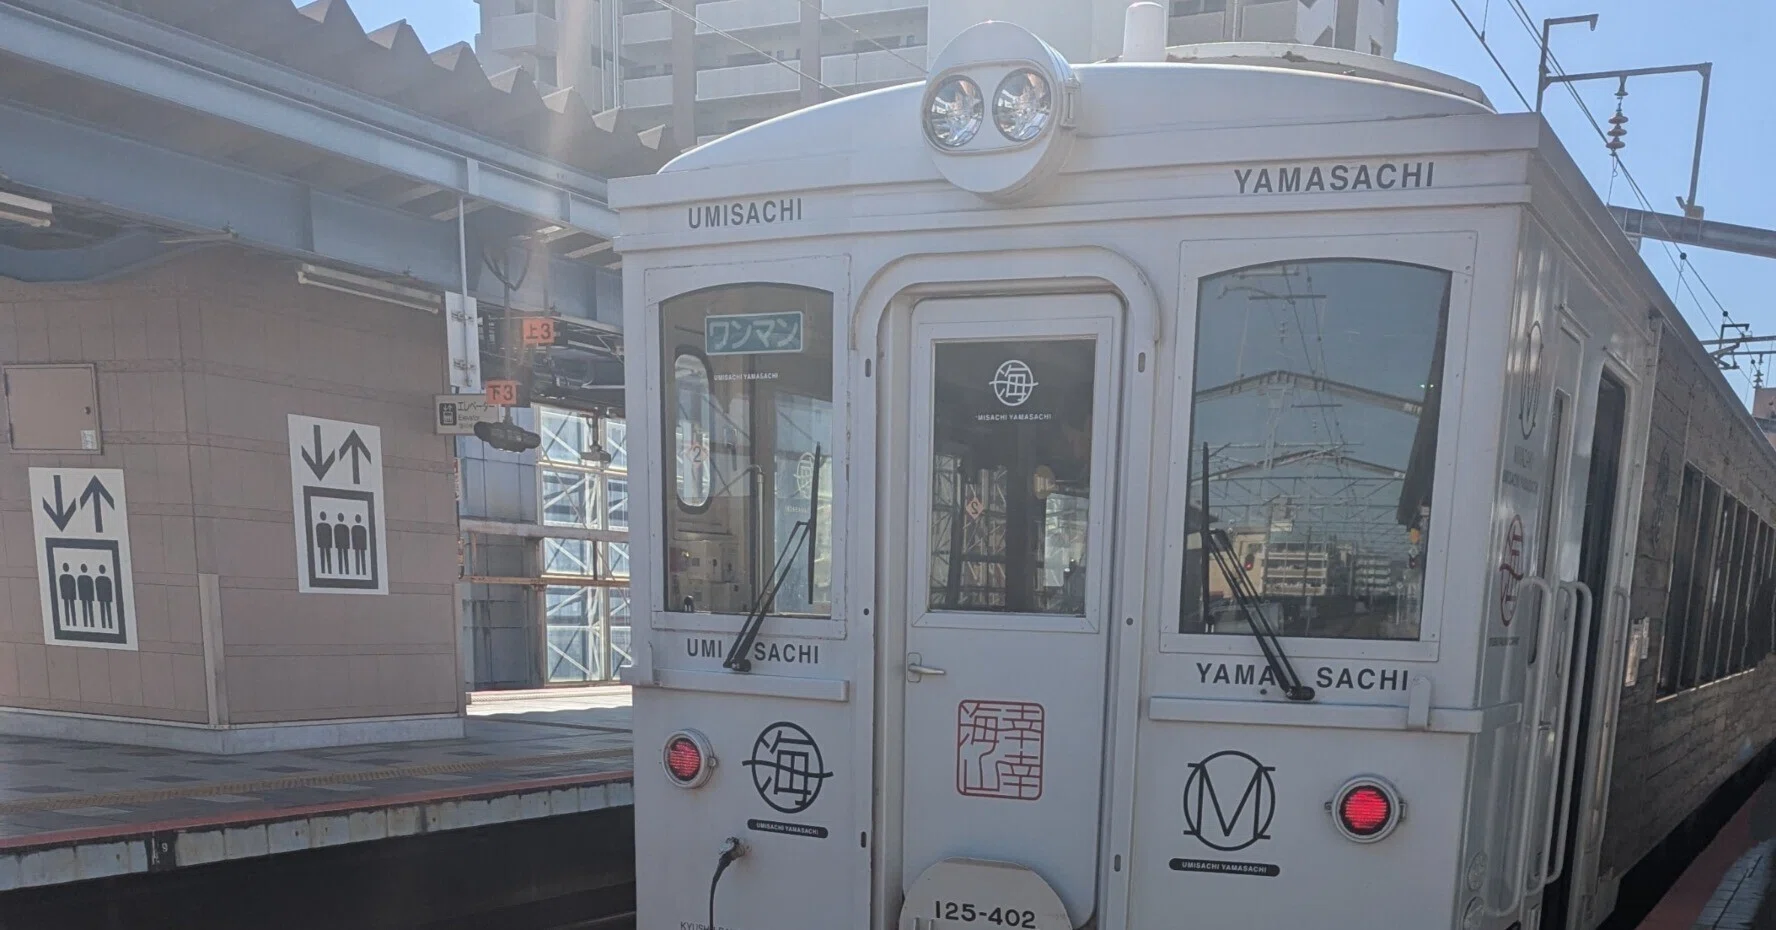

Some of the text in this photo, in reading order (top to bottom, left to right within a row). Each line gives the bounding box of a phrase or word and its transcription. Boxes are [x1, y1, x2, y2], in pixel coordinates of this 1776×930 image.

[1234, 161, 1434, 194] YAMASACHI
[688, 197, 802, 229] UMISACHI
[525, 322, 552, 340] 上3
[708, 318, 799, 350] ワンマン
[713, 372, 779, 381] UMISACHI YAMASACHI
[988, 360, 1040, 406] 海
[487, 383, 514, 401] 下3
[976, 412, 1052, 421] MISACHI YAMASACHI
[686, 638, 819, 664] UMI SACHI
[1196, 662, 1409, 691] YAMA SACHI
[742, 721, 834, 814] 海
[756, 822, 819, 835] UMISACHI YAMASACHI
[1181, 861, 1267, 873] UMISACHI YAMASACHI
[935, 900, 1036, 929] 125-402
